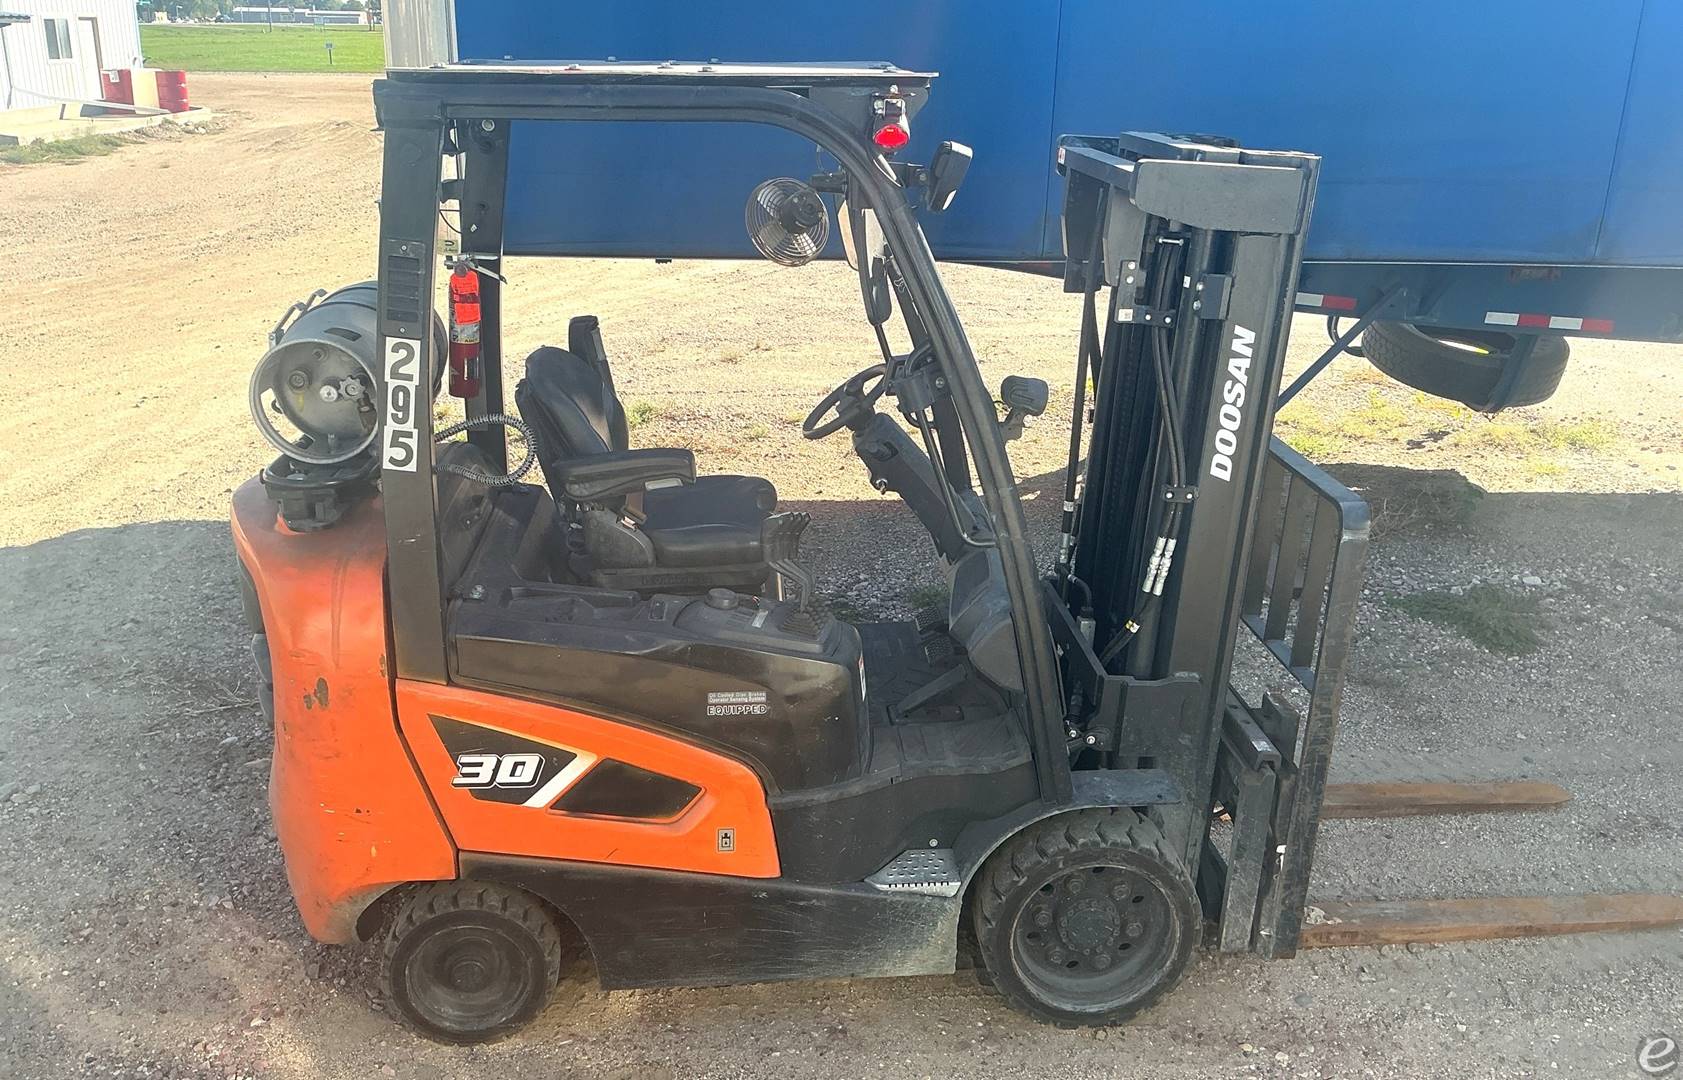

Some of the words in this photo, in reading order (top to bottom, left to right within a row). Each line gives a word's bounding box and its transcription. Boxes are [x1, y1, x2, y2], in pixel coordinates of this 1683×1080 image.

[1210, 325, 1256, 482] DOOSAN
[707, 704, 767, 715] EQUIPPED
[451, 754, 545, 789] 30
